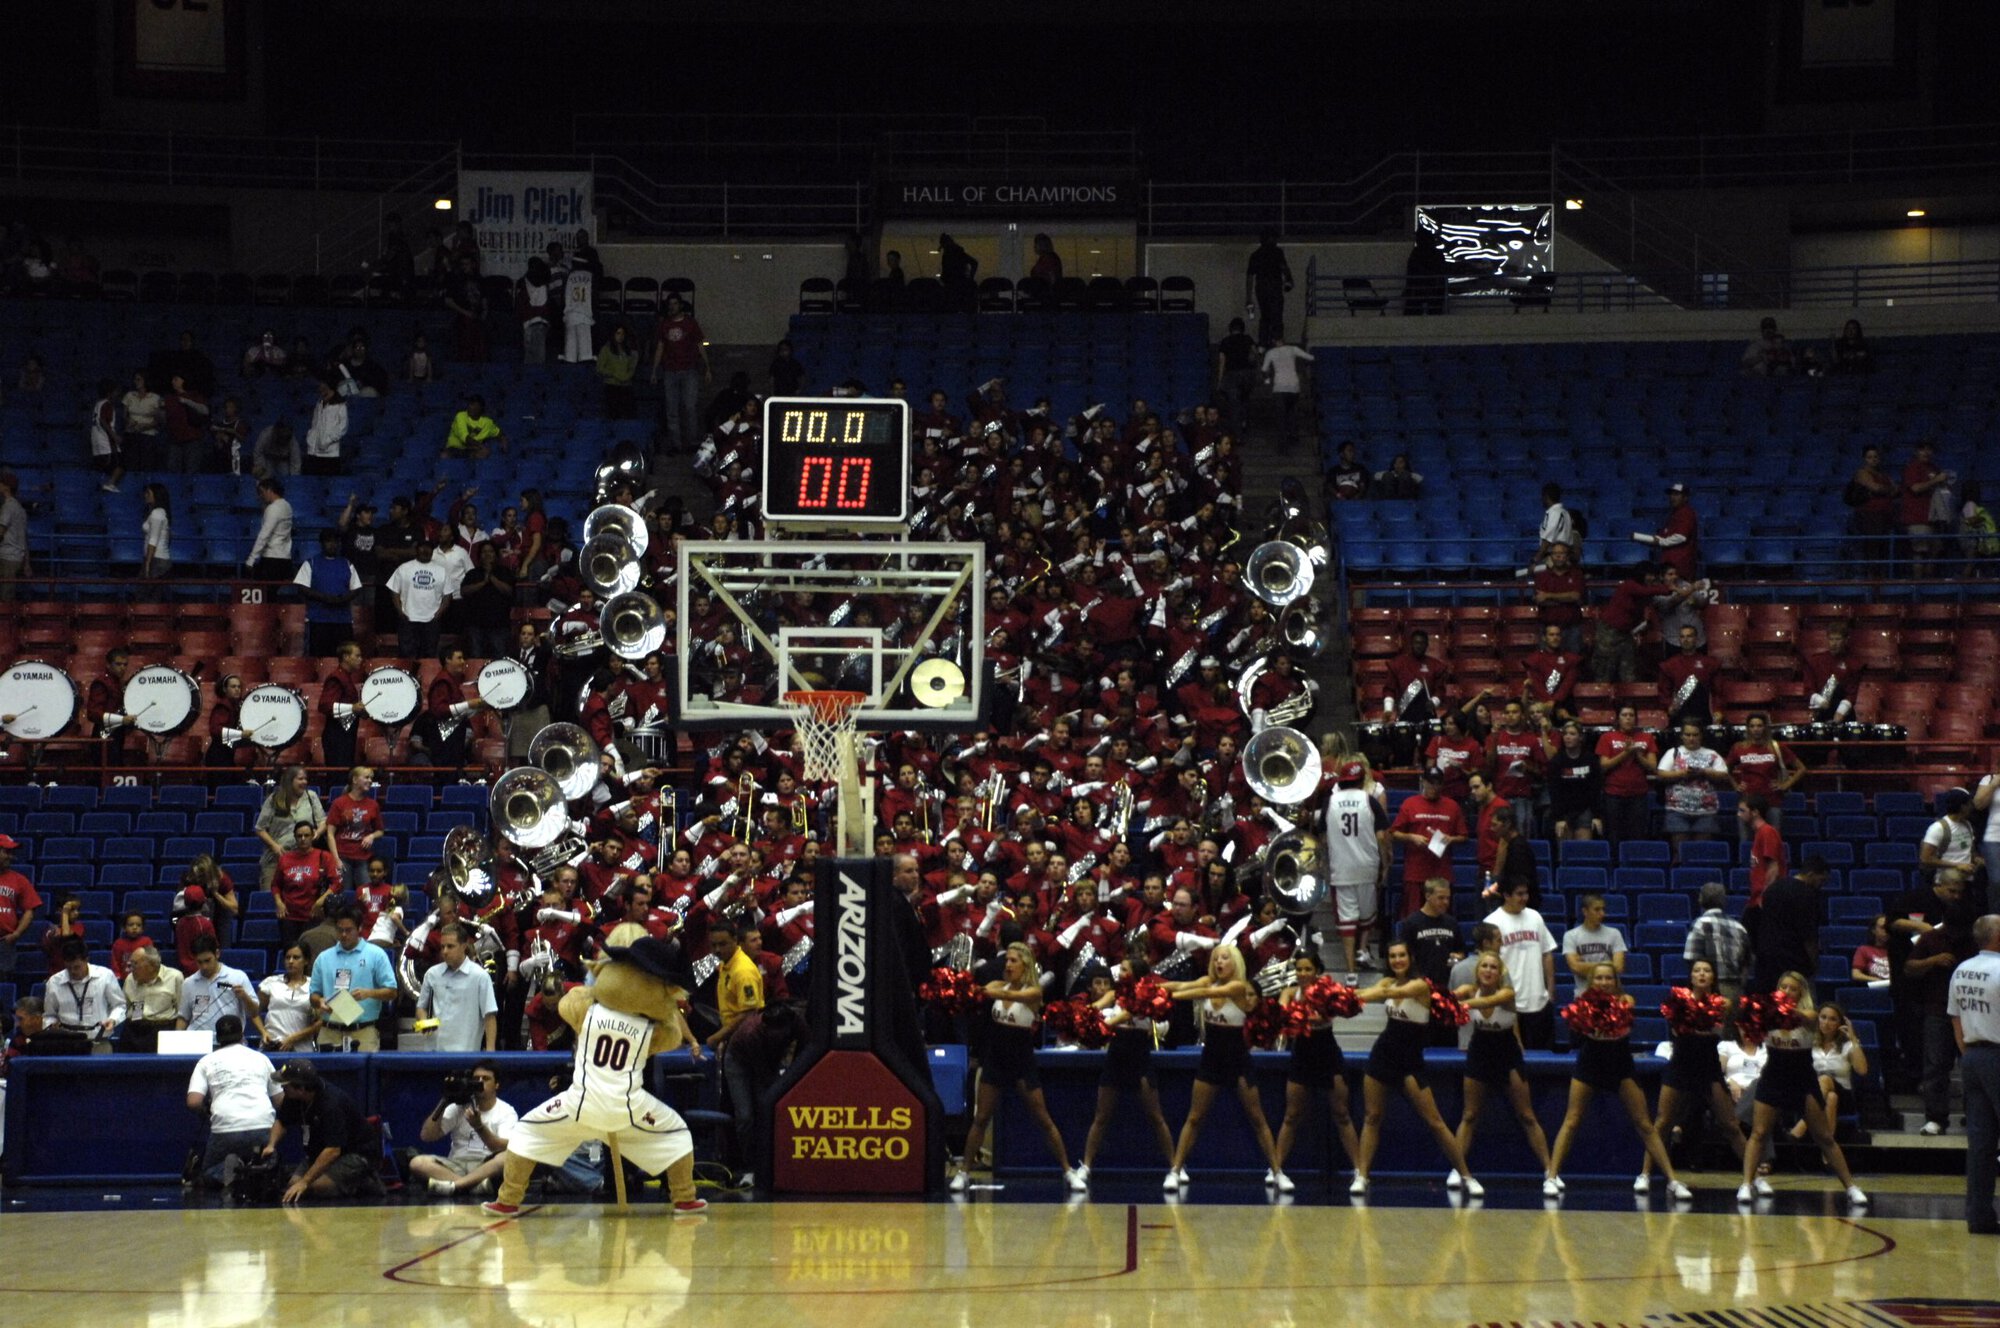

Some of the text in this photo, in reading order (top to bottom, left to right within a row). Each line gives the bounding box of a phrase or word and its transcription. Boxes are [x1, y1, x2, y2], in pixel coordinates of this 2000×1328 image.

[902, 186, 1117, 203] HALL OF CHAMPIONS
[469, 187, 583, 225] Jim Click
[782, 411, 864, 443] 00.0
[798, 457, 873, 508] 00
[241, 588, 262, 604] 20
[22, 672, 53, 681] YAMAHA
[491, 666, 517, 677] YAMAHA
[147, 675, 177, 684] YAMAHA
[378, 676, 404, 685] YAMAHA
[260, 695, 291, 704] YAMAHA
[113, 775, 137, 787] 20
[1341, 812, 1358, 837] 31
[1416, 928, 1454, 938] ARIZONA
[1502, 931, 1540, 945] ARIZONA
[837, 871, 866, 1034] ARIZONA
[1576, 943, 1613, 955] ARIZONA
[1956, 971, 1990, 981] EVENT
[1956, 986, 1985, 997] STAFF
[597, 1019, 640, 1039] WILBUR
[593, 1035, 630, 1071] 00
[788, 1106, 912, 1130] WELLS
[792, 1136, 910, 1160] FARGO
